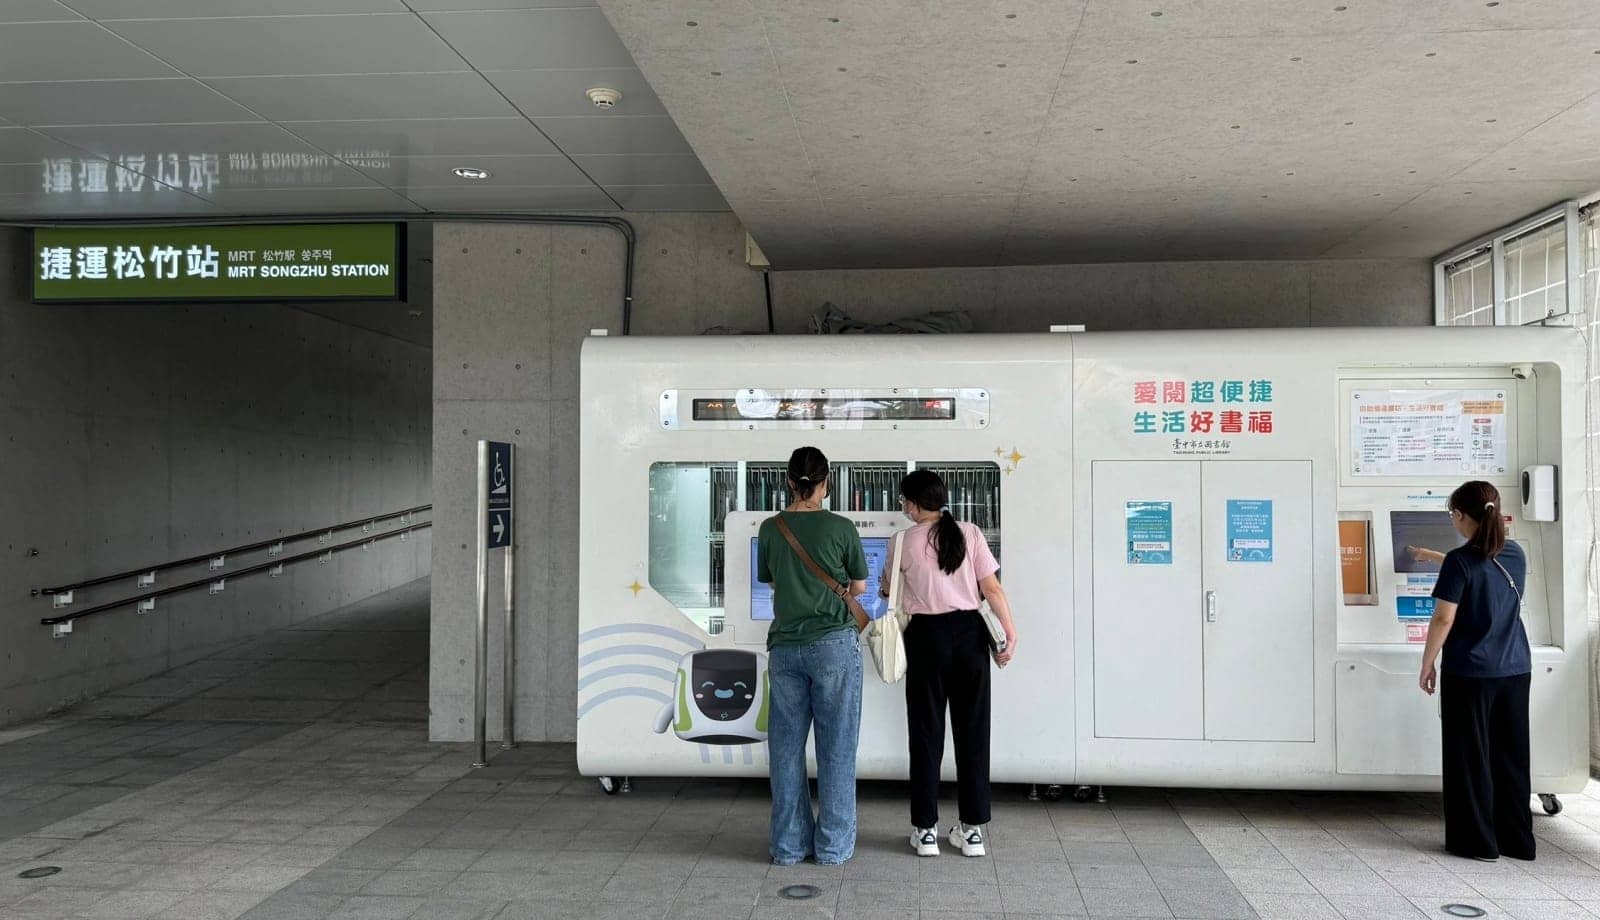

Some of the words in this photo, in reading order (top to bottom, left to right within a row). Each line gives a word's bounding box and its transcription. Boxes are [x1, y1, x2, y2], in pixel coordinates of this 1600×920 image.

[40, 245, 220, 280] 捷運松竹站
[228, 250, 256, 262] MRT
[263, 250, 295, 262] 松竹駅
[228, 266, 256, 278] MRT
[260, 265, 327, 277] SONGZHU
[331, 264, 389, 276] STATION
[1134, 380, 1273, 404] 愛閱超便捷
[1134, 410, 1273, 434] 生活好書福
